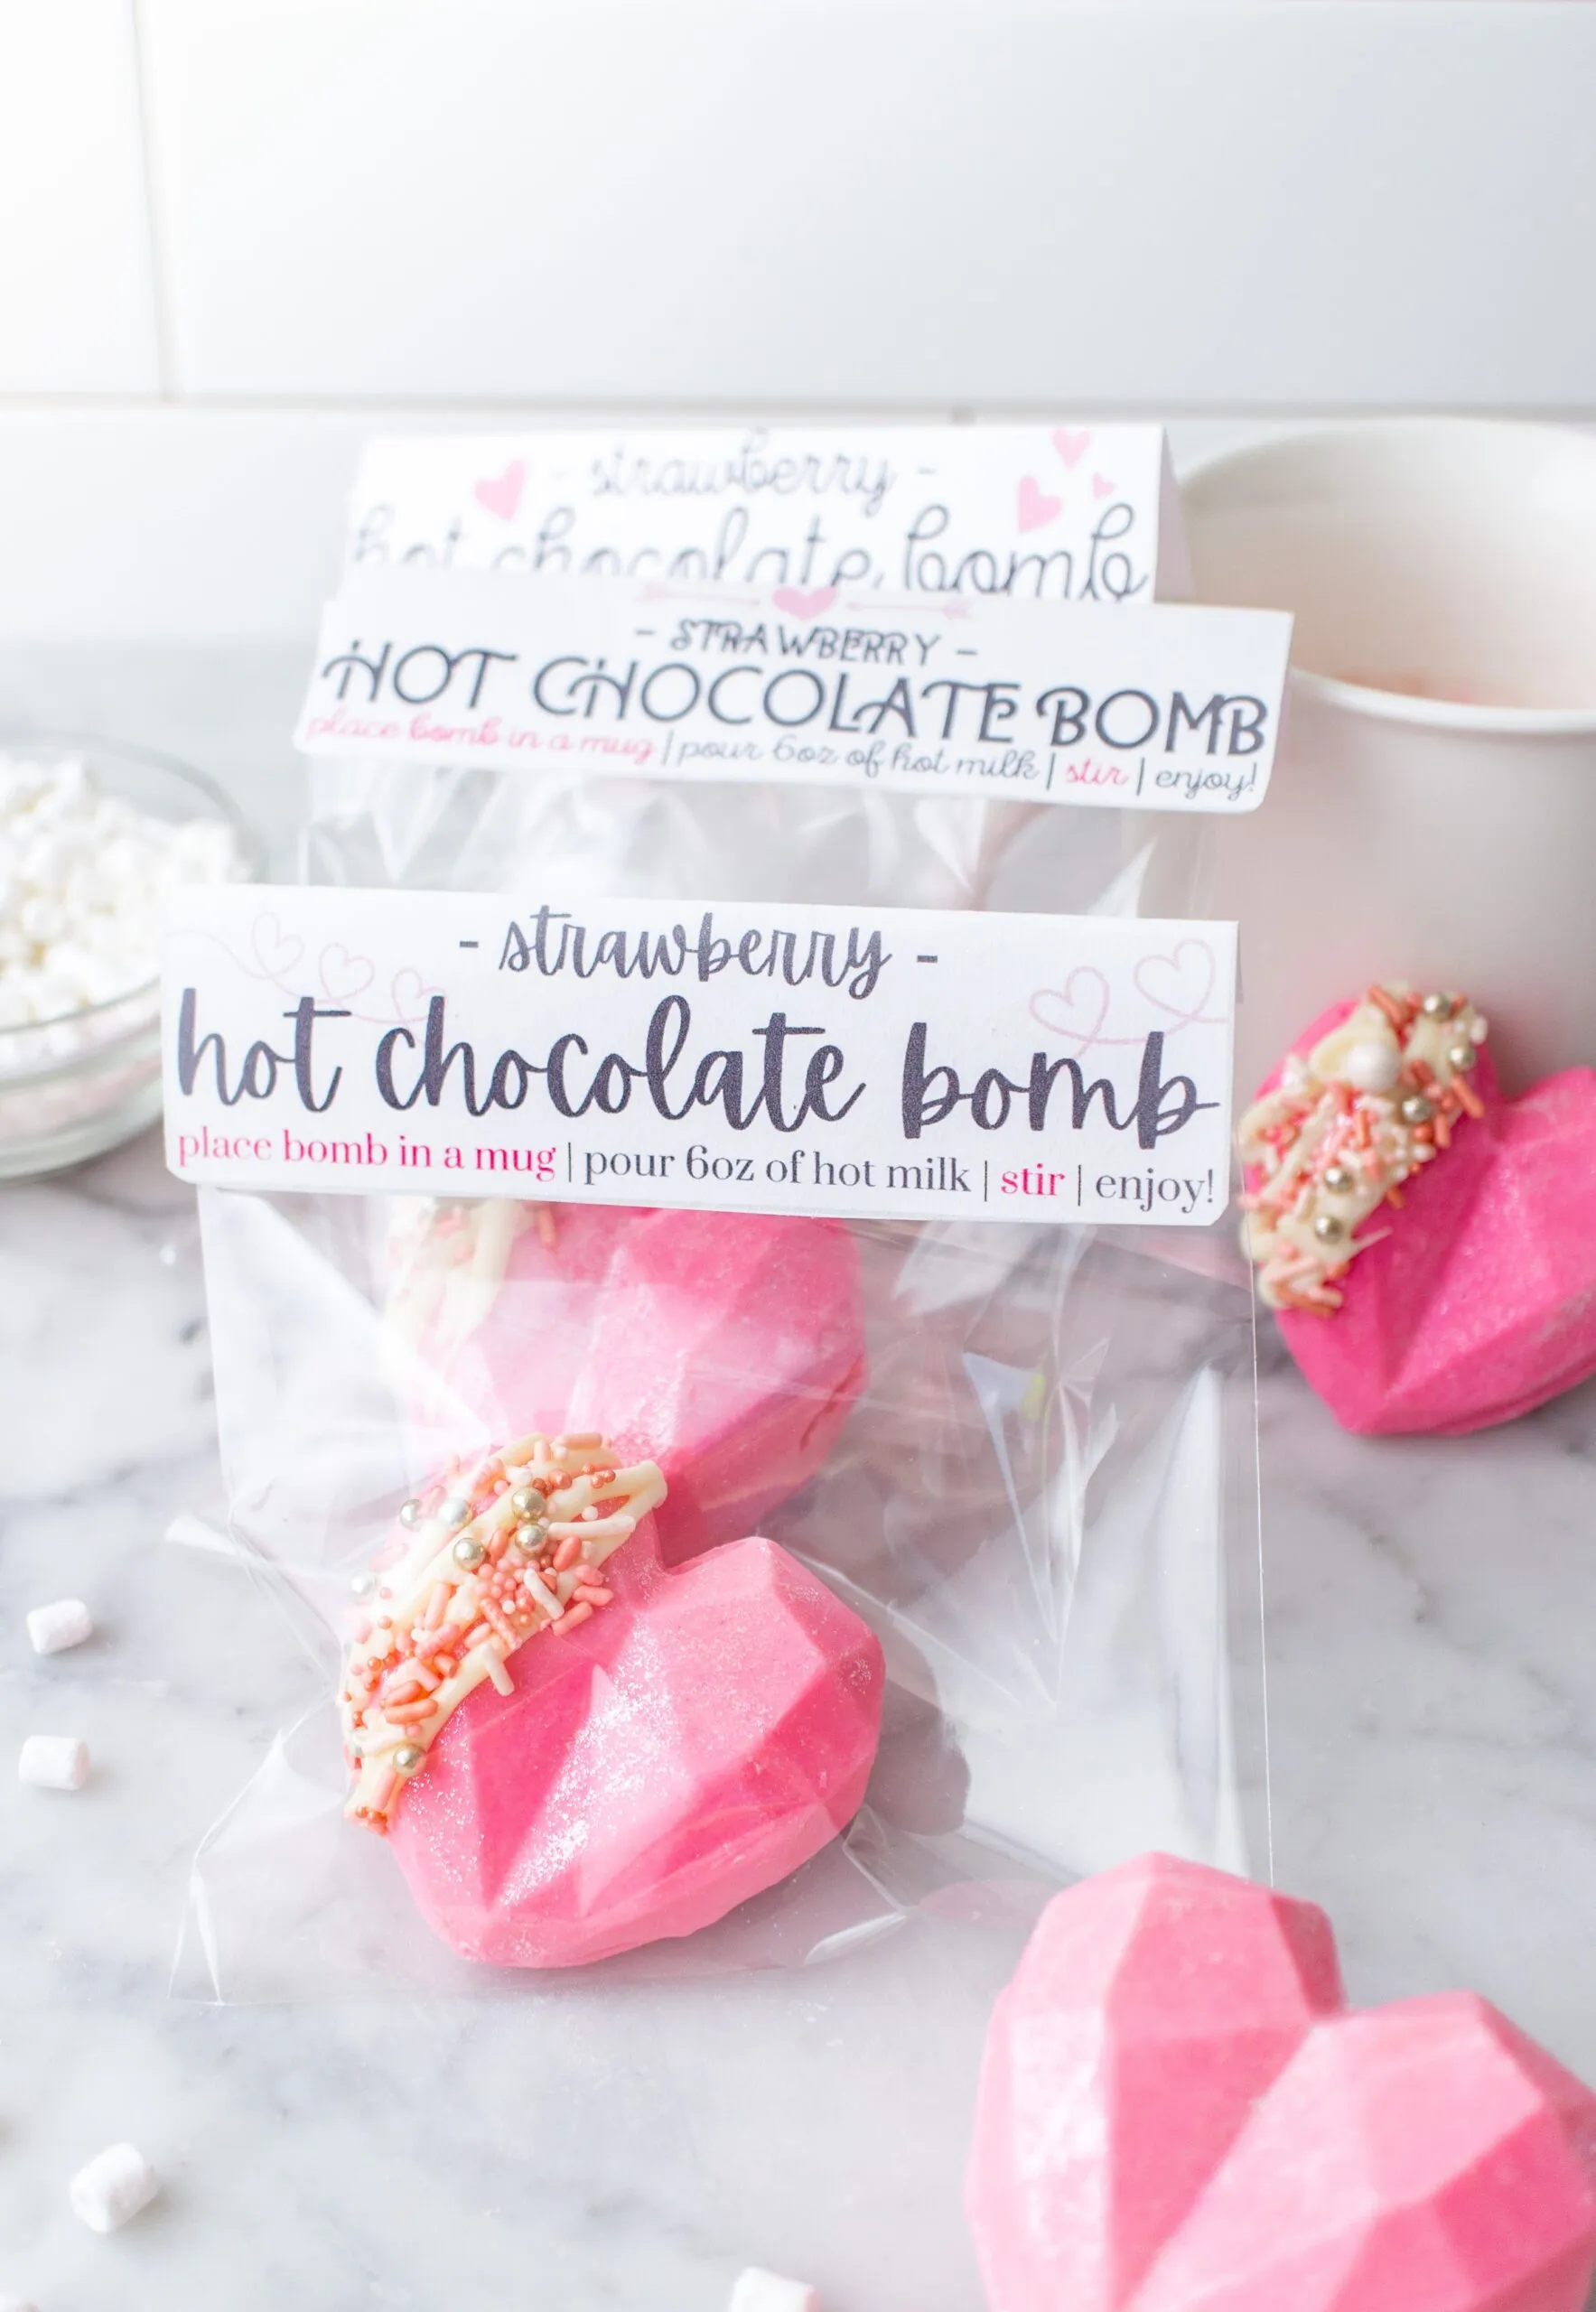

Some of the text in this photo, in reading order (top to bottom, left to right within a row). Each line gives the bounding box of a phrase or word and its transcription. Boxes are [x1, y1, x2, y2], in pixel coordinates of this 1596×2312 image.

[591, 426, 899, 518] strawberry
[904, 502, 1150, 601] bomb
[671, 618, 942, 667] STRAWBERRY
[322, 639, 1269, 757] HOT CHOCOLATE BOMB
[305, 706, 400, 741] place
[407, 713, 502, 746] bomb
[508, 725, 541, 751] in
[548, 732, 573, 751] a
[580, 735, 656, 765] mug
[677, 737, 762, 768] pour
[772, 733, 839, 764] 6oz
[845, 740, 885, 778] of
[891, 742, 950, 774] hot
[956, 749, 1041, 781] milk
[1065, 757, 1130, 786] stir
[1155, 761, 1258, 800] enjoy!
[498, 905, 892, 1000] strawberry
[179, 988, 1220, 1150] hot chocolate bomb
[180, 1126, 272, 1167] place
[284, 1129, 387, 1166] bomb
[399, 1135, 433, 1169] in
[443, 1147, 465, 1170] a
[475, 1146, 557, 1181] mug
[583, 1149, 676, 1185] pour
[686, 1144, 755, 1182] 6oz
[766, 1150, 806, 1184] of
[814, 1151, 876, 1188] hot
[886, 1157, 972, 1193] milk
[1001, 1163, 1065, 1197] stir
[1096, 1167, 1215, 1214] enjoy!
